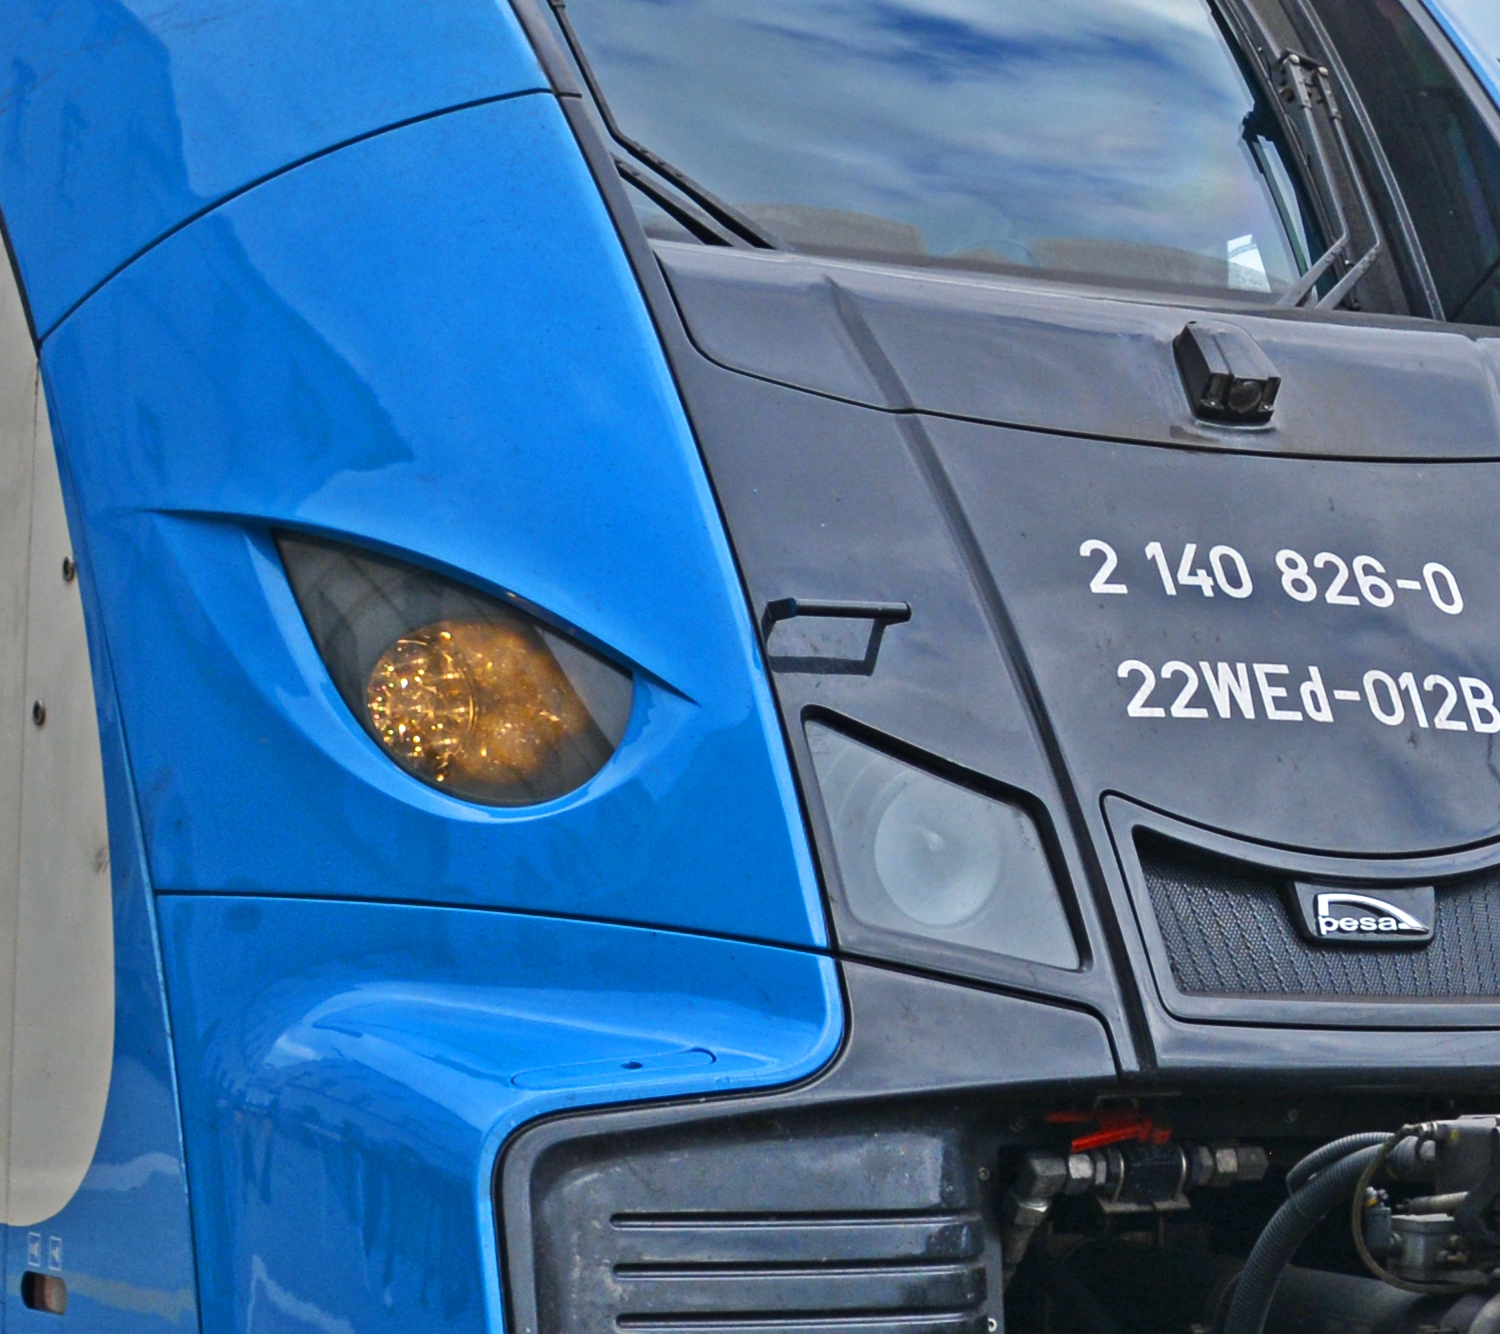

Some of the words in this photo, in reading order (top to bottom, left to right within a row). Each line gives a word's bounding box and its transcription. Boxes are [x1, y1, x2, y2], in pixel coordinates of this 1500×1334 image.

[1079, 539, 1128, 595] 2
[1145, 541, 1254, 599] 140
[1275, 549, 1465, 615] 826-0
[1317, 914, 1398, 936] pesa
